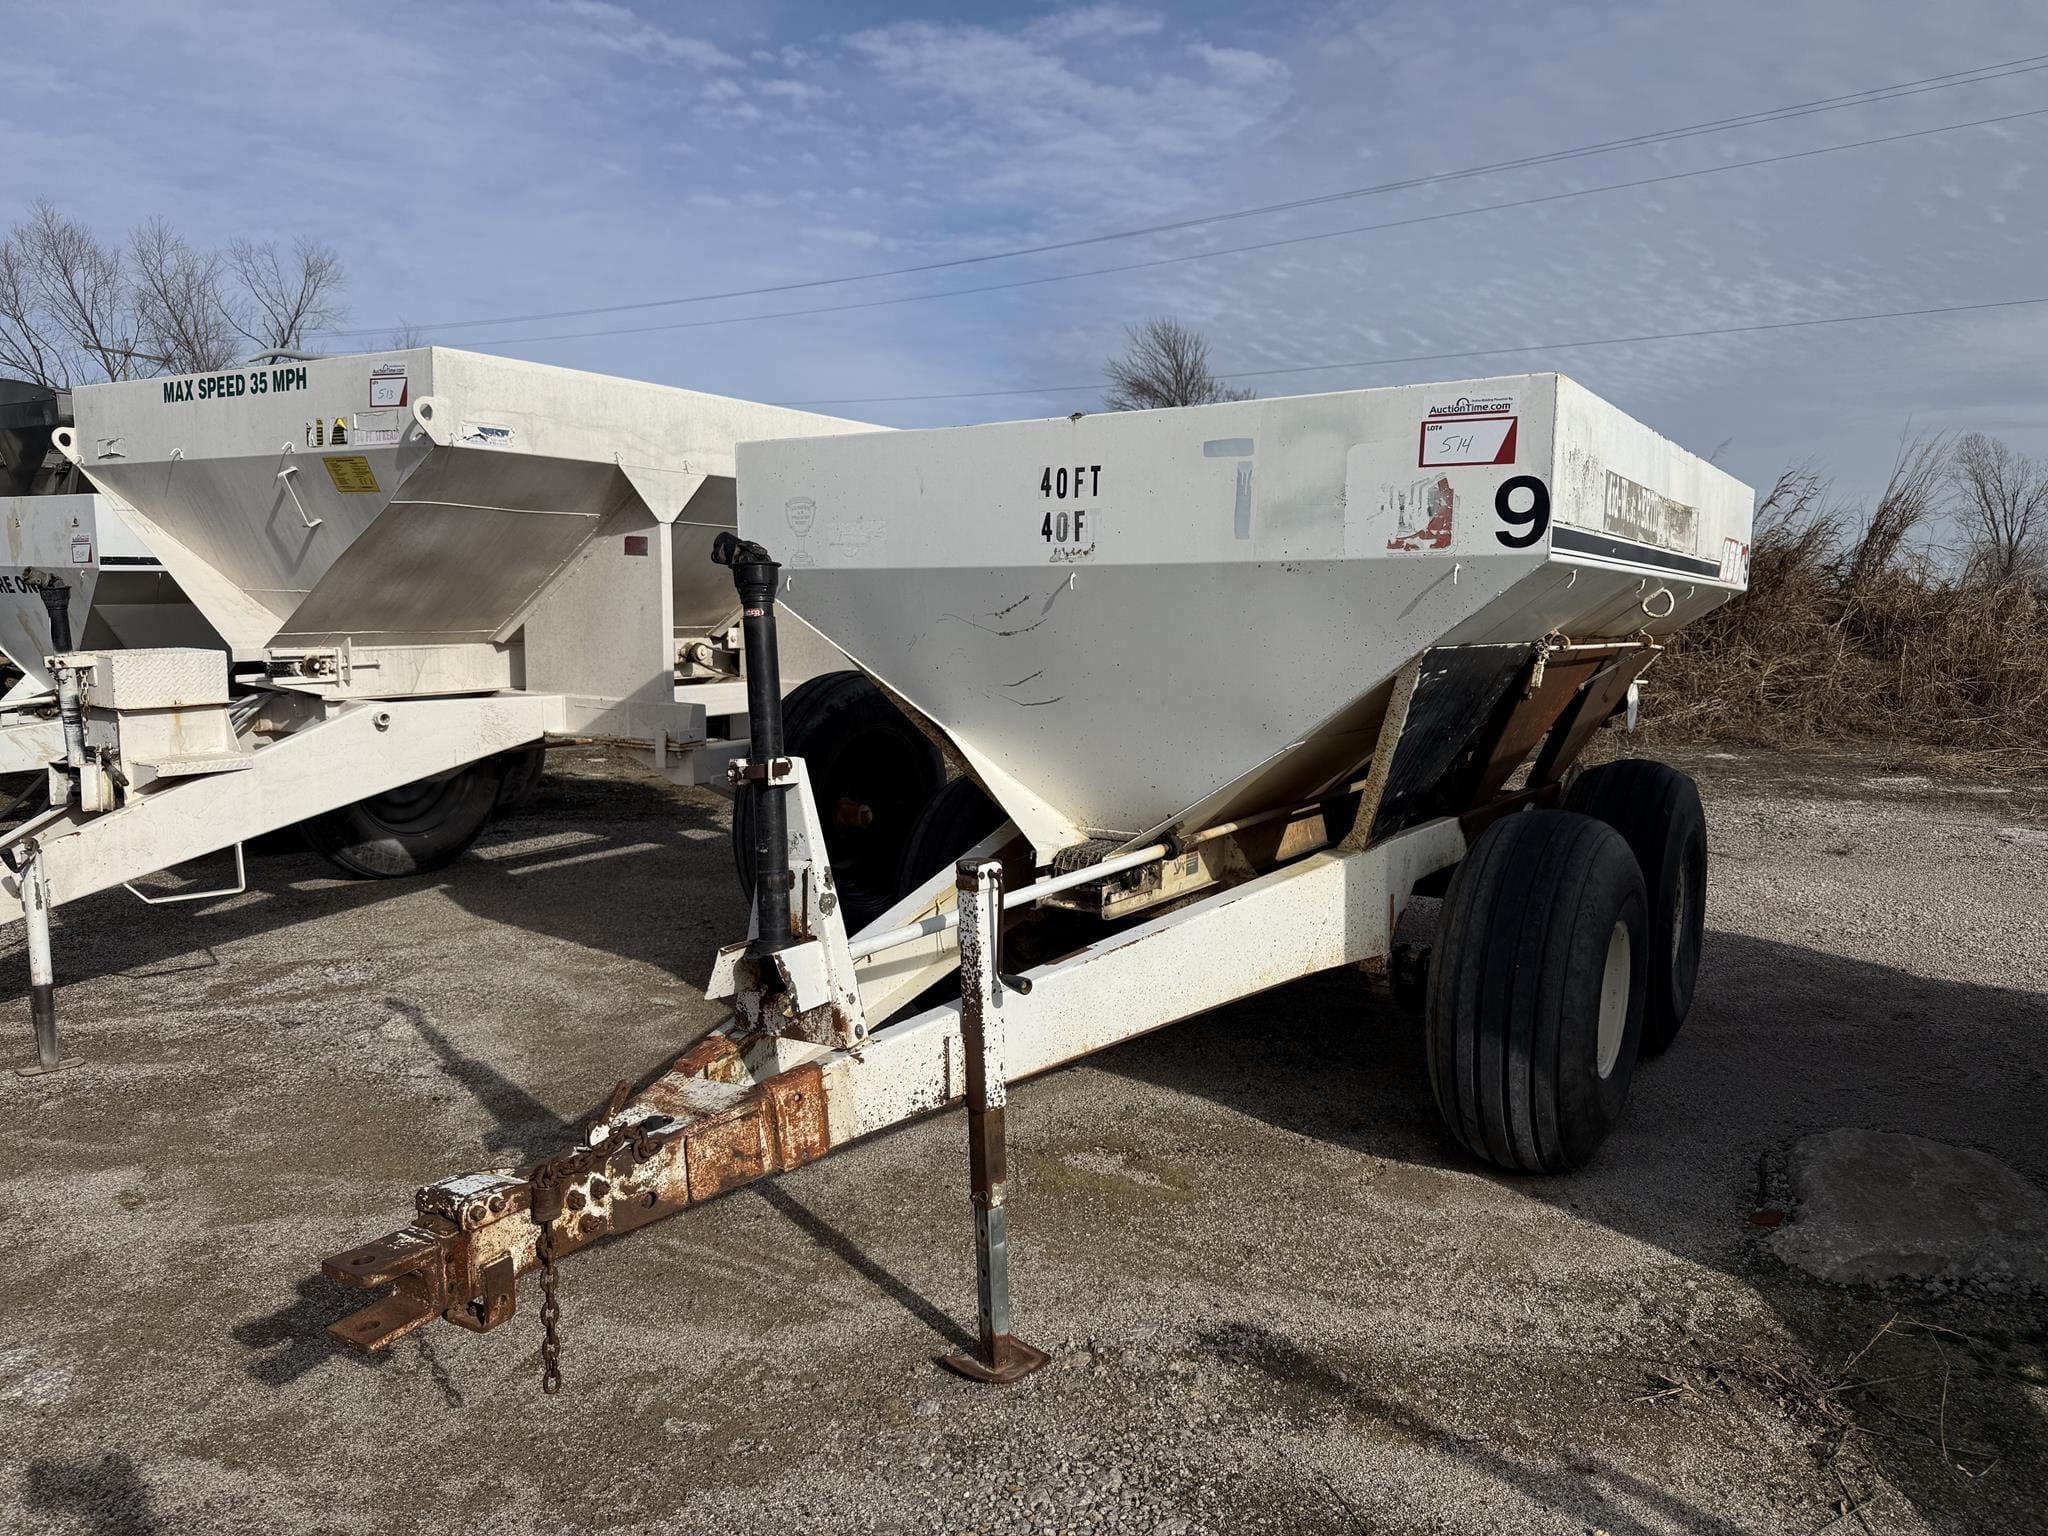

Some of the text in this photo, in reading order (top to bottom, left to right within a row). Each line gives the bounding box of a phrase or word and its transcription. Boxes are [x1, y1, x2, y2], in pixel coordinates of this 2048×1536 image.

[163, 366, 307, 403] MAX SPEED 35 MPH
[1430, 403, 1511, 414] AuctionTime.com
[1440, 435, 1474, 454] 514
[1494, 475, 1550, 549] 9
